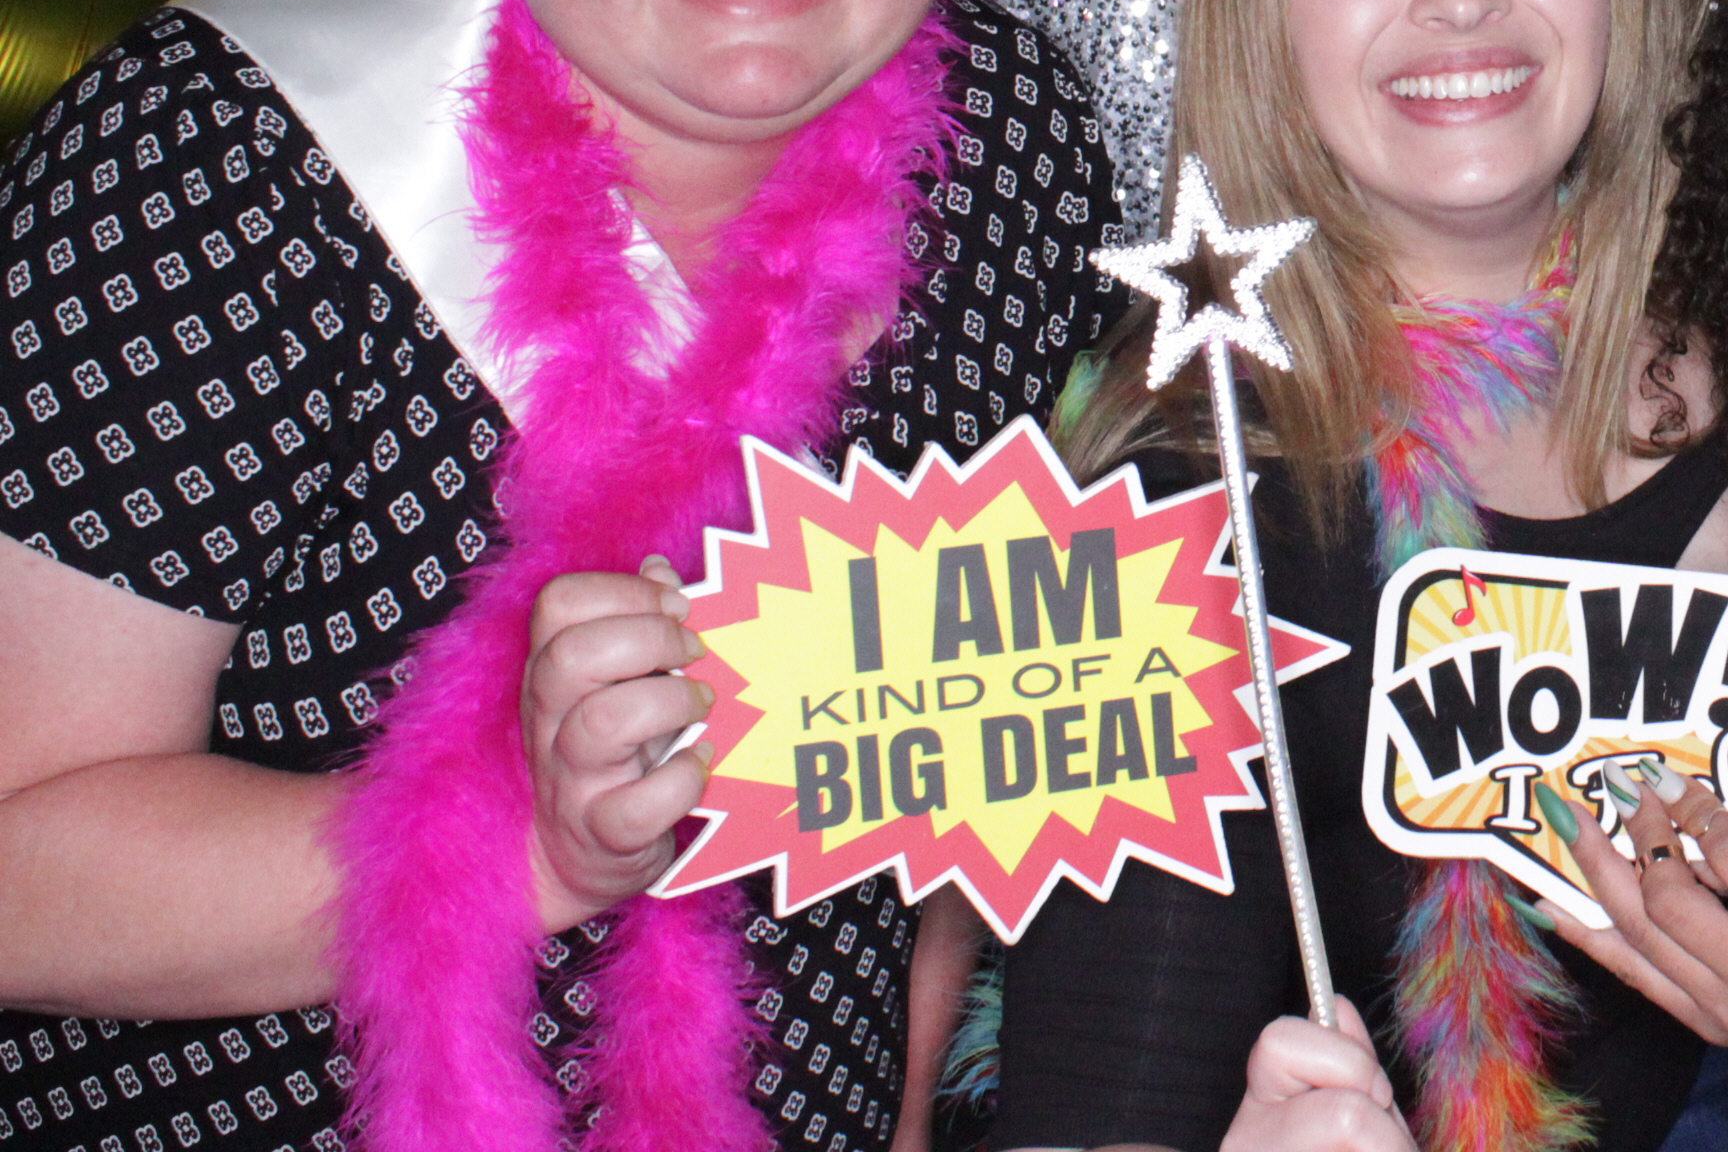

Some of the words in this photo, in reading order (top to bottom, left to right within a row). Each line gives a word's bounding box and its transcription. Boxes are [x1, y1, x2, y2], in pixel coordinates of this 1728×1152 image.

[847, 556, 885, 674] I
[931, 527, 1122, 663] AM
[801, 672, 985, 731] KIND
[1011, 653, 1112, 700] OF
[1134, 646, 1182, 684] A
[793, 725, 947, 834] BIG
[979, 691, 1198, 805] DEAL
[1483, 762, 1544, 836] I
